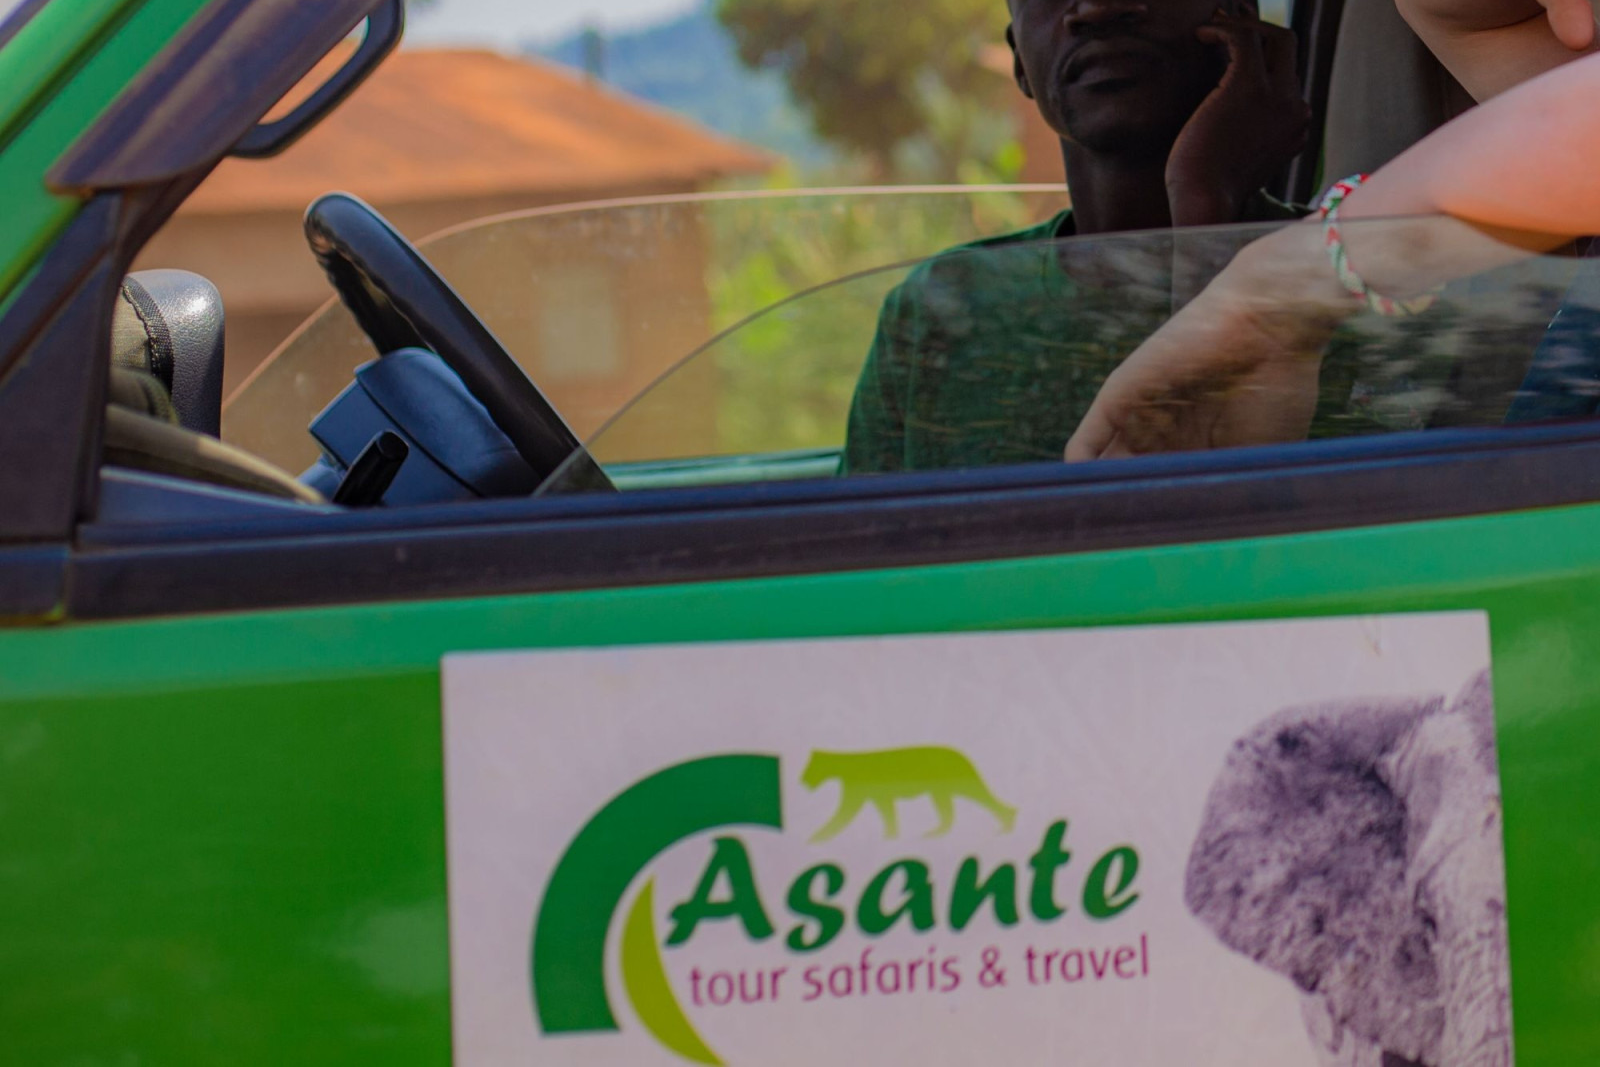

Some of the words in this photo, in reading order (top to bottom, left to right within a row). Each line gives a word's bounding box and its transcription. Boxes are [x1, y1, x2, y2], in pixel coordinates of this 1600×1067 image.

[664, 819, 1140, 953] Asante
[689, 965, 787, 1007] tour
[802, 946, 961, 1002] safaris
[978, 945, 1007, 988] &
[1025, 933, 1150, 985] travel
